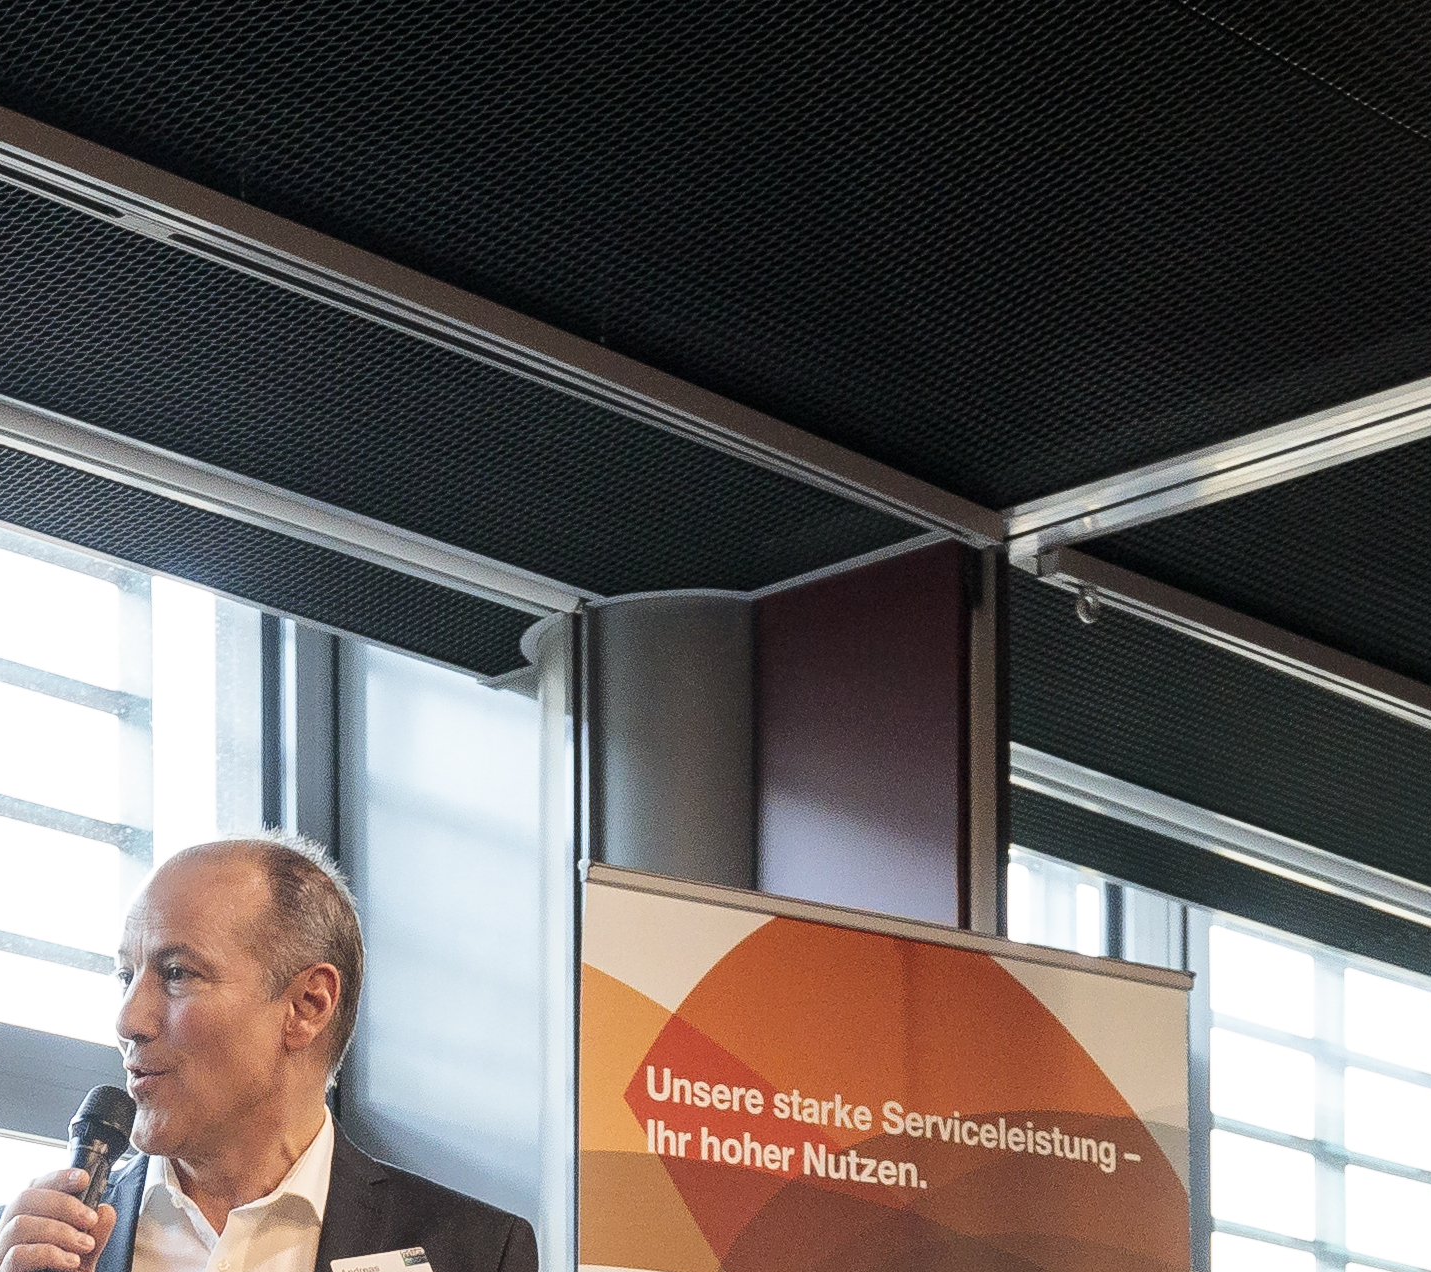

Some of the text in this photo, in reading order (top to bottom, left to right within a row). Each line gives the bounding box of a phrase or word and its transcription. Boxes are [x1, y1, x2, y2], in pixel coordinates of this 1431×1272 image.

[646, 1066, 765, 1116] Unsere
[773, 1089, 872, 1131] starke
[881, 1102, 1117, 1172] Serviceleistung
[646, 1120, 927, 1189] Ihr hoher Nutzen.
